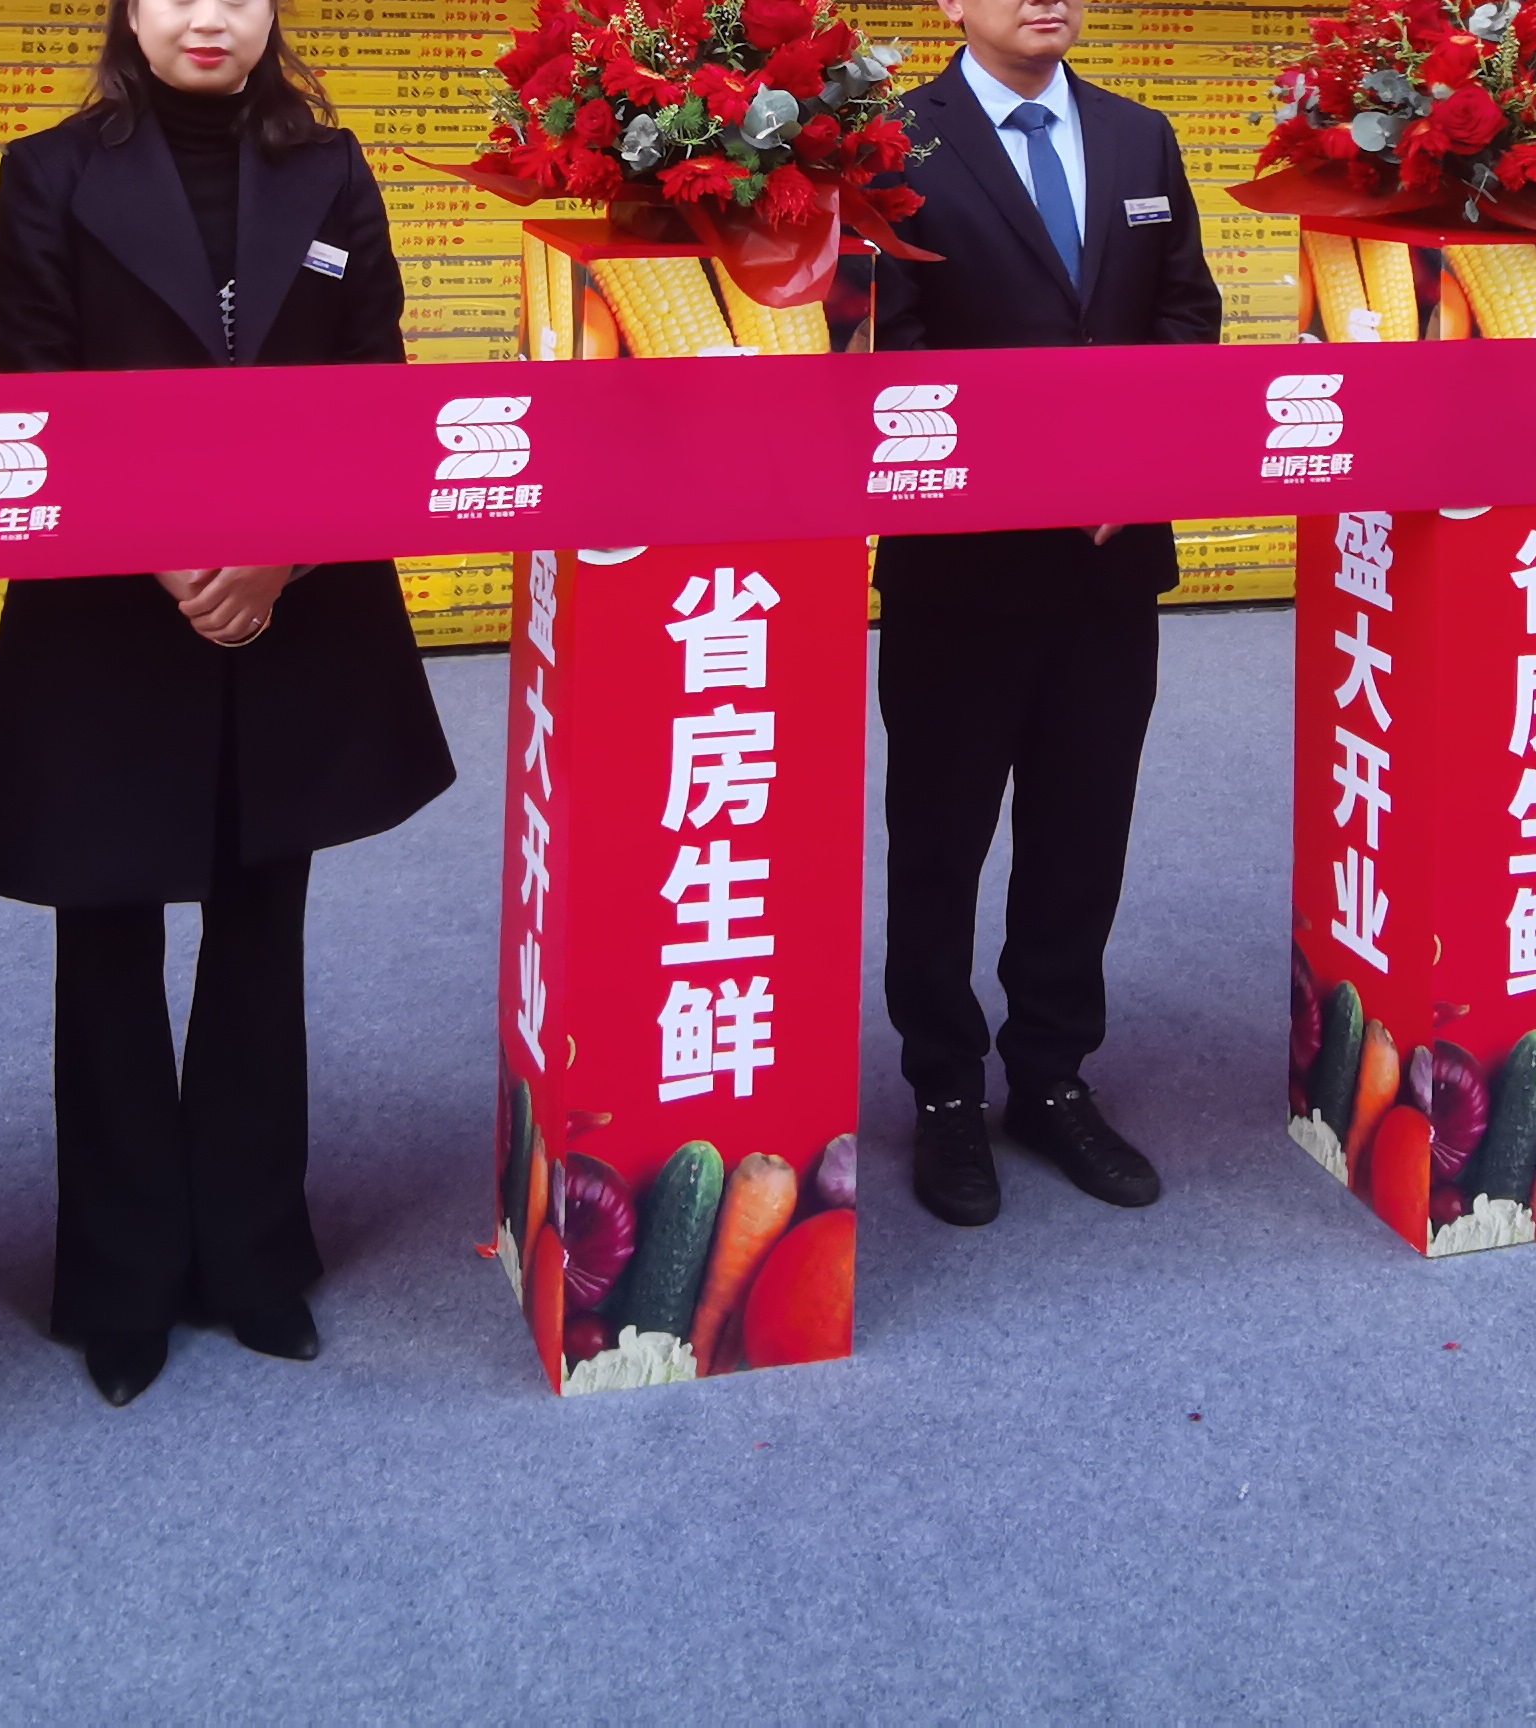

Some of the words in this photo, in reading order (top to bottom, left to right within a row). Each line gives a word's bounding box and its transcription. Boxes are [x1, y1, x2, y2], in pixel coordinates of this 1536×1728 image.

[429, 485, 543, 512] 省房生鲜
[867, 468, 968, 493] 省房生鲜
[1261, 454, 1354, 477] 省房生鲜
[518, 552, 557, 1071] 盛大开业
[657, 568, 780, 1102] 省房生鲜
[1332, 512, 1393, 973] 盛大开业
